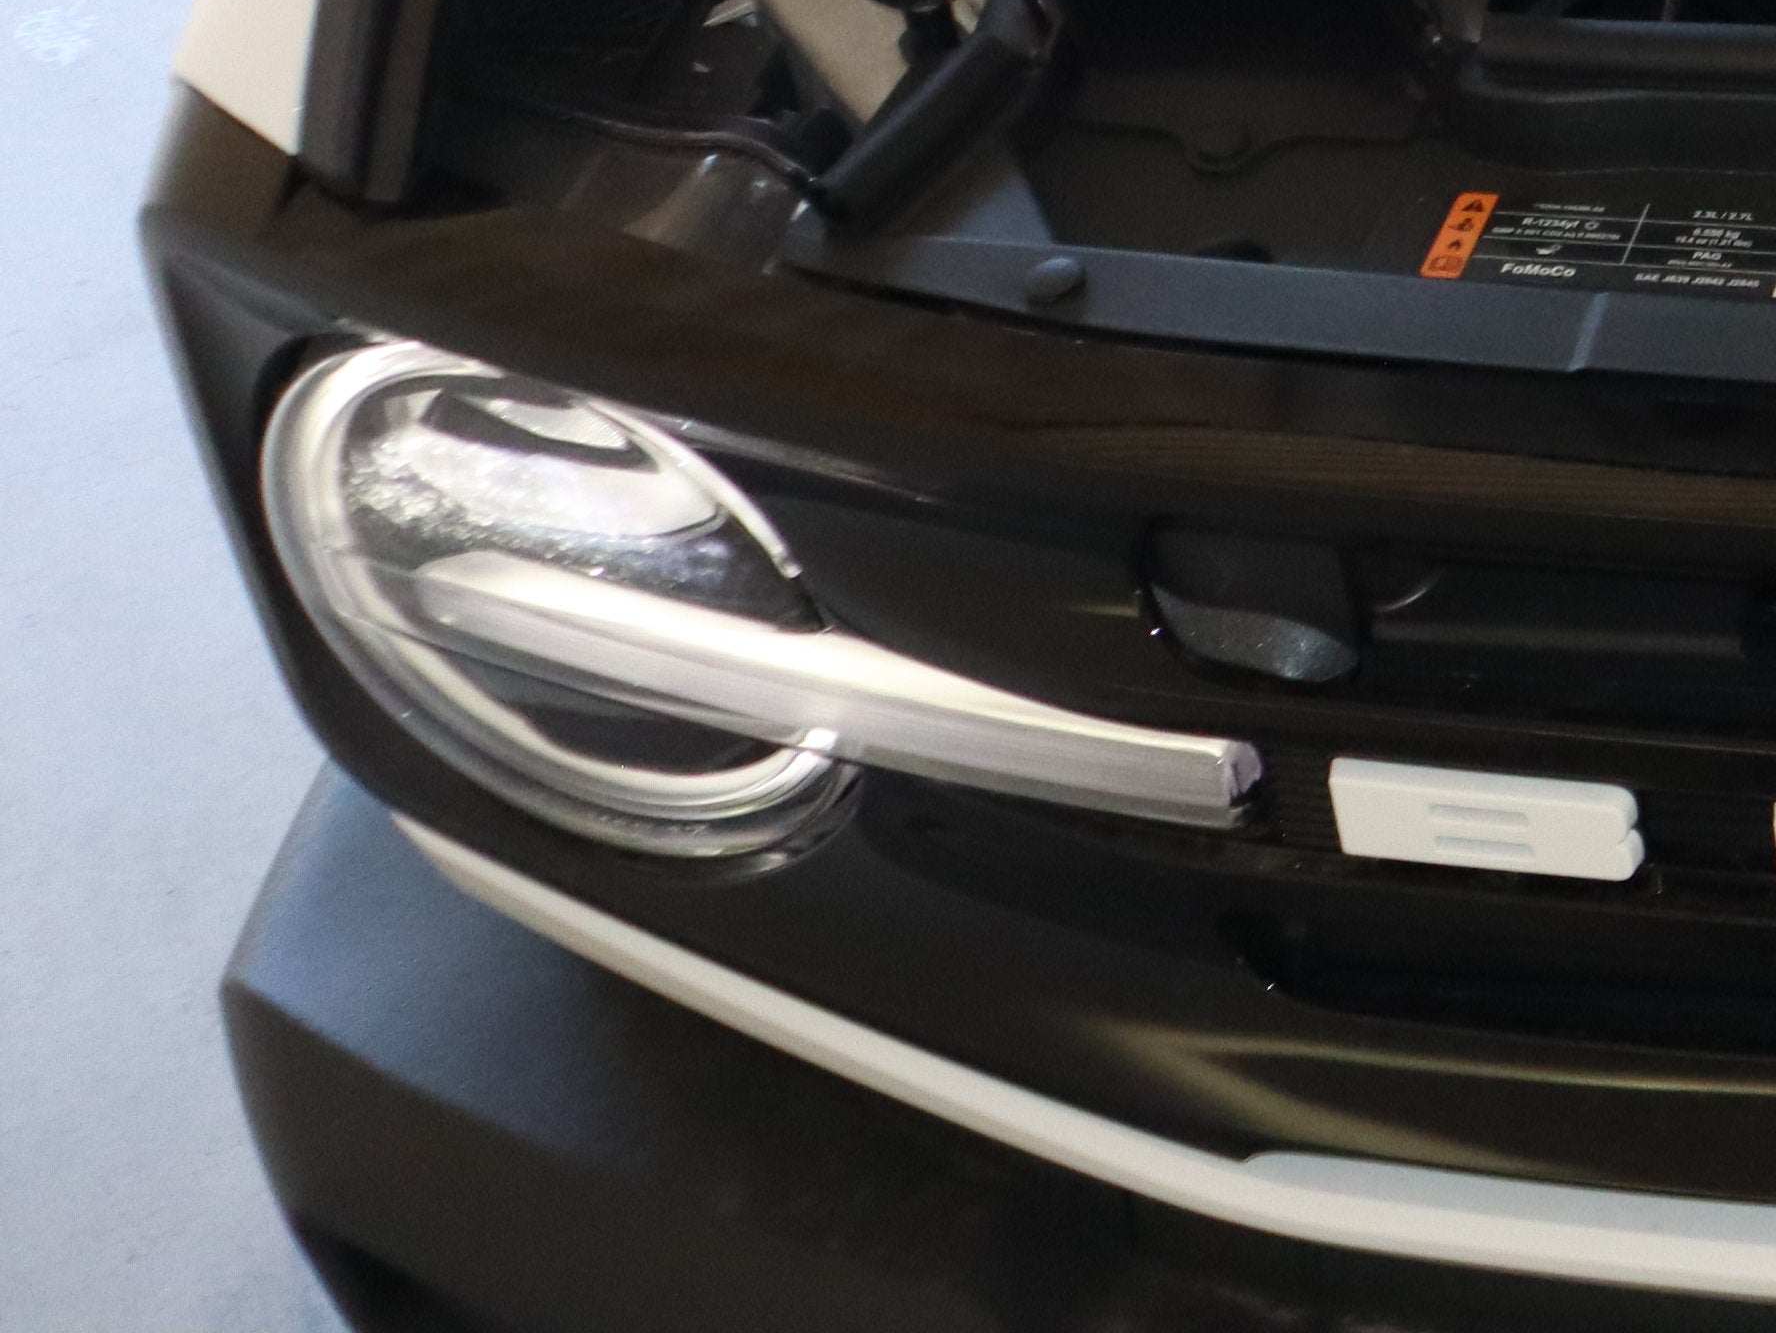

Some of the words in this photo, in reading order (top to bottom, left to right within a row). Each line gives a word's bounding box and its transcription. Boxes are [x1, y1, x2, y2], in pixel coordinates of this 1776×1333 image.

[1728, 212, 1753, 222] 2.7L
[1521, 217, 1581, 229] R-1234yf
[1692, 252, 1723, 261] PAG
[1500, 262, 1577, 278] FoMoCo
